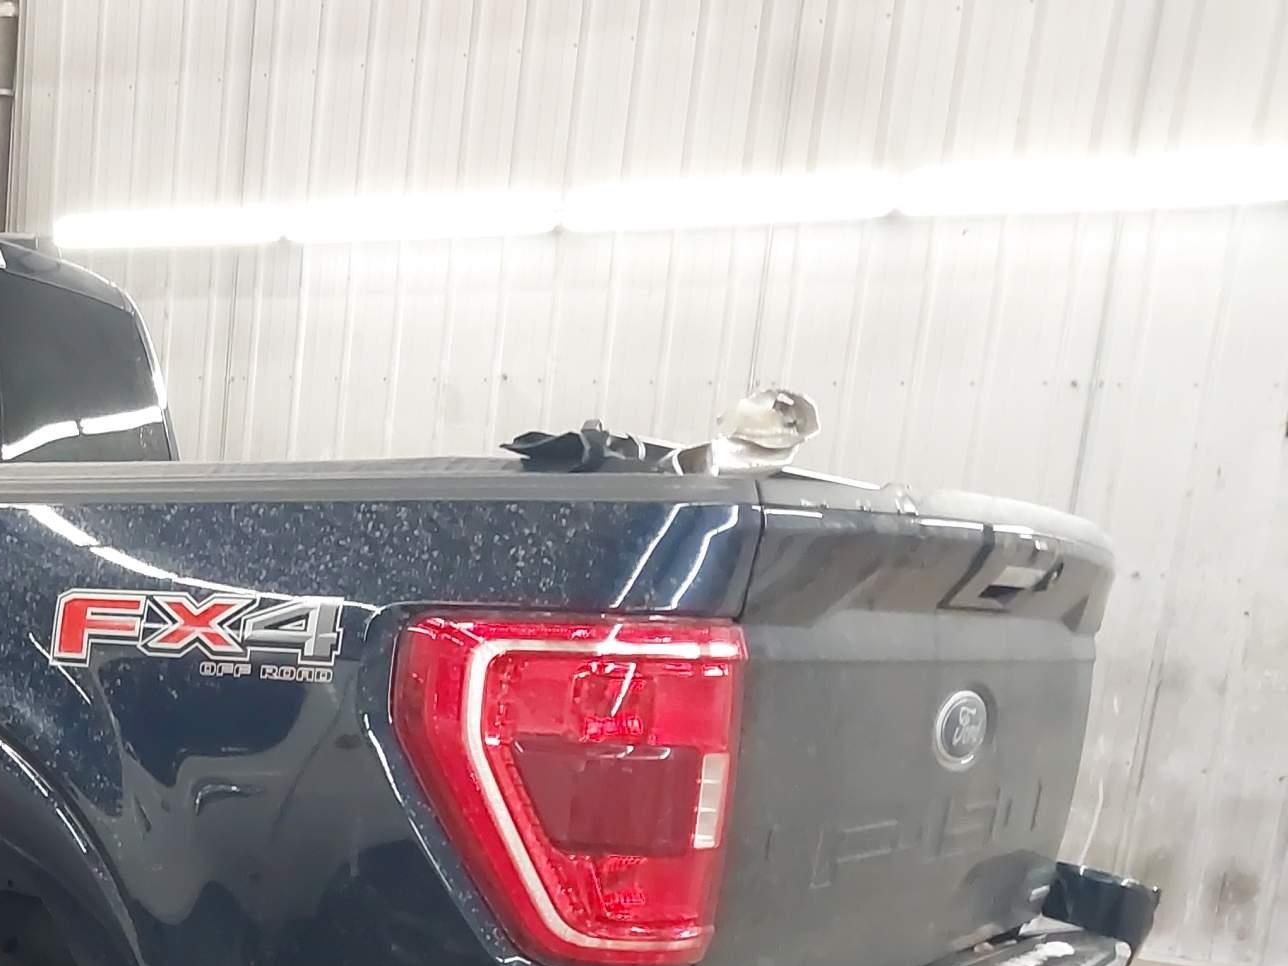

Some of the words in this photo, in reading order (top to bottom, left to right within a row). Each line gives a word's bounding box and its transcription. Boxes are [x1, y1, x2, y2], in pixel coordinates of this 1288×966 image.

[50, 588, 344, 667] FX4
[200, 661, 251, 677] OFF
[260, 665, 333, 682] ROAD
[951, 705, 985, 747] Ford
